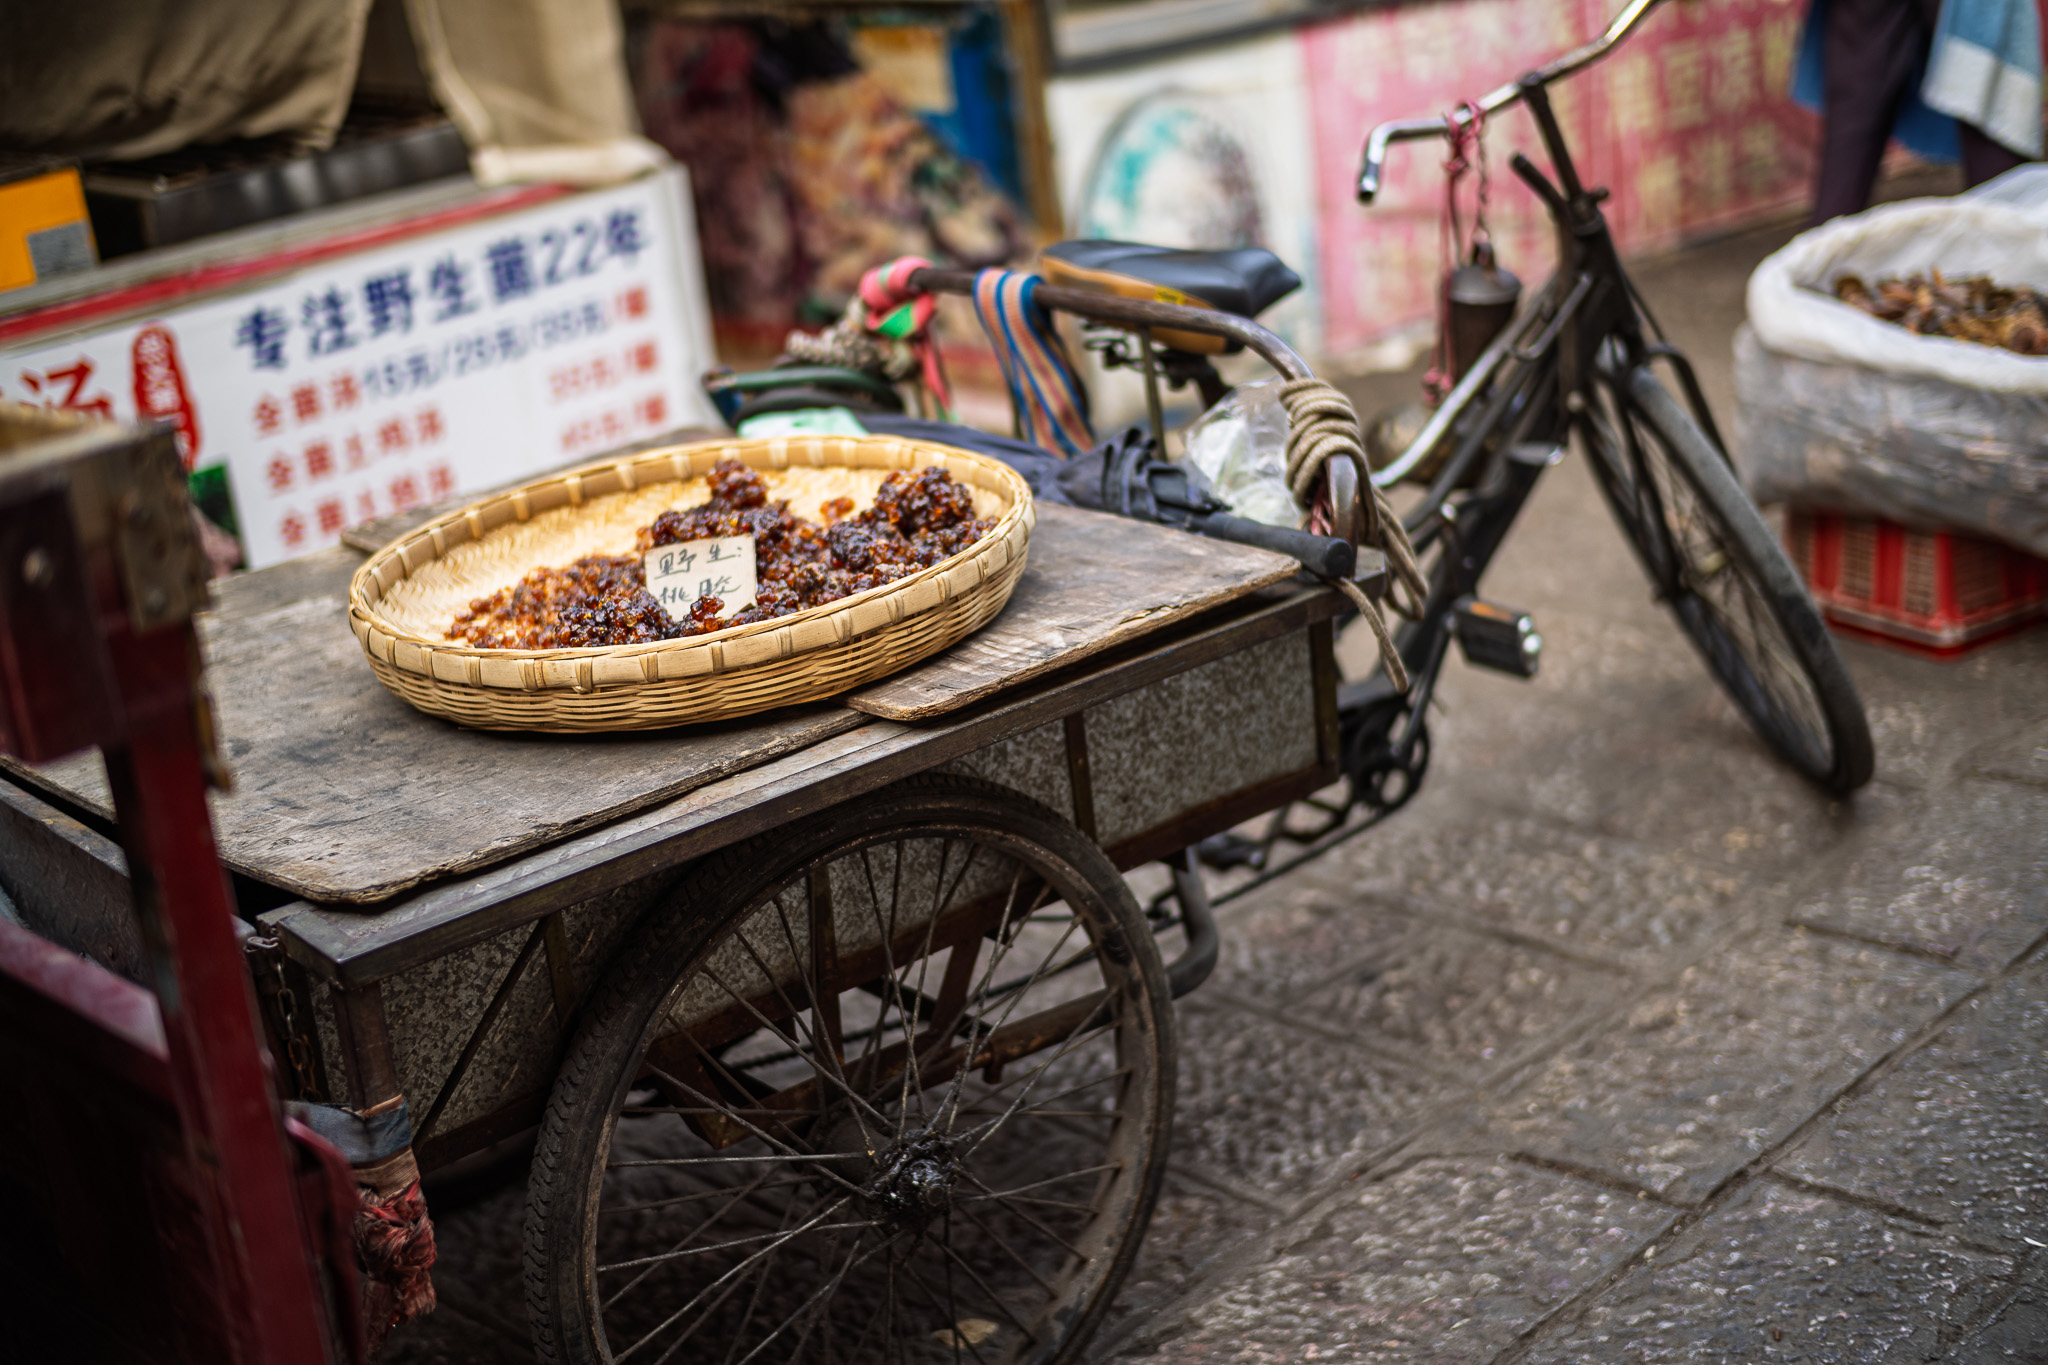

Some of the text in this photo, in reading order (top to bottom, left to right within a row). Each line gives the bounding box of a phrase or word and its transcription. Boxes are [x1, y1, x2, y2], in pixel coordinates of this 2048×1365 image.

[234, 207, 654, 371] 专注野生菌22年
